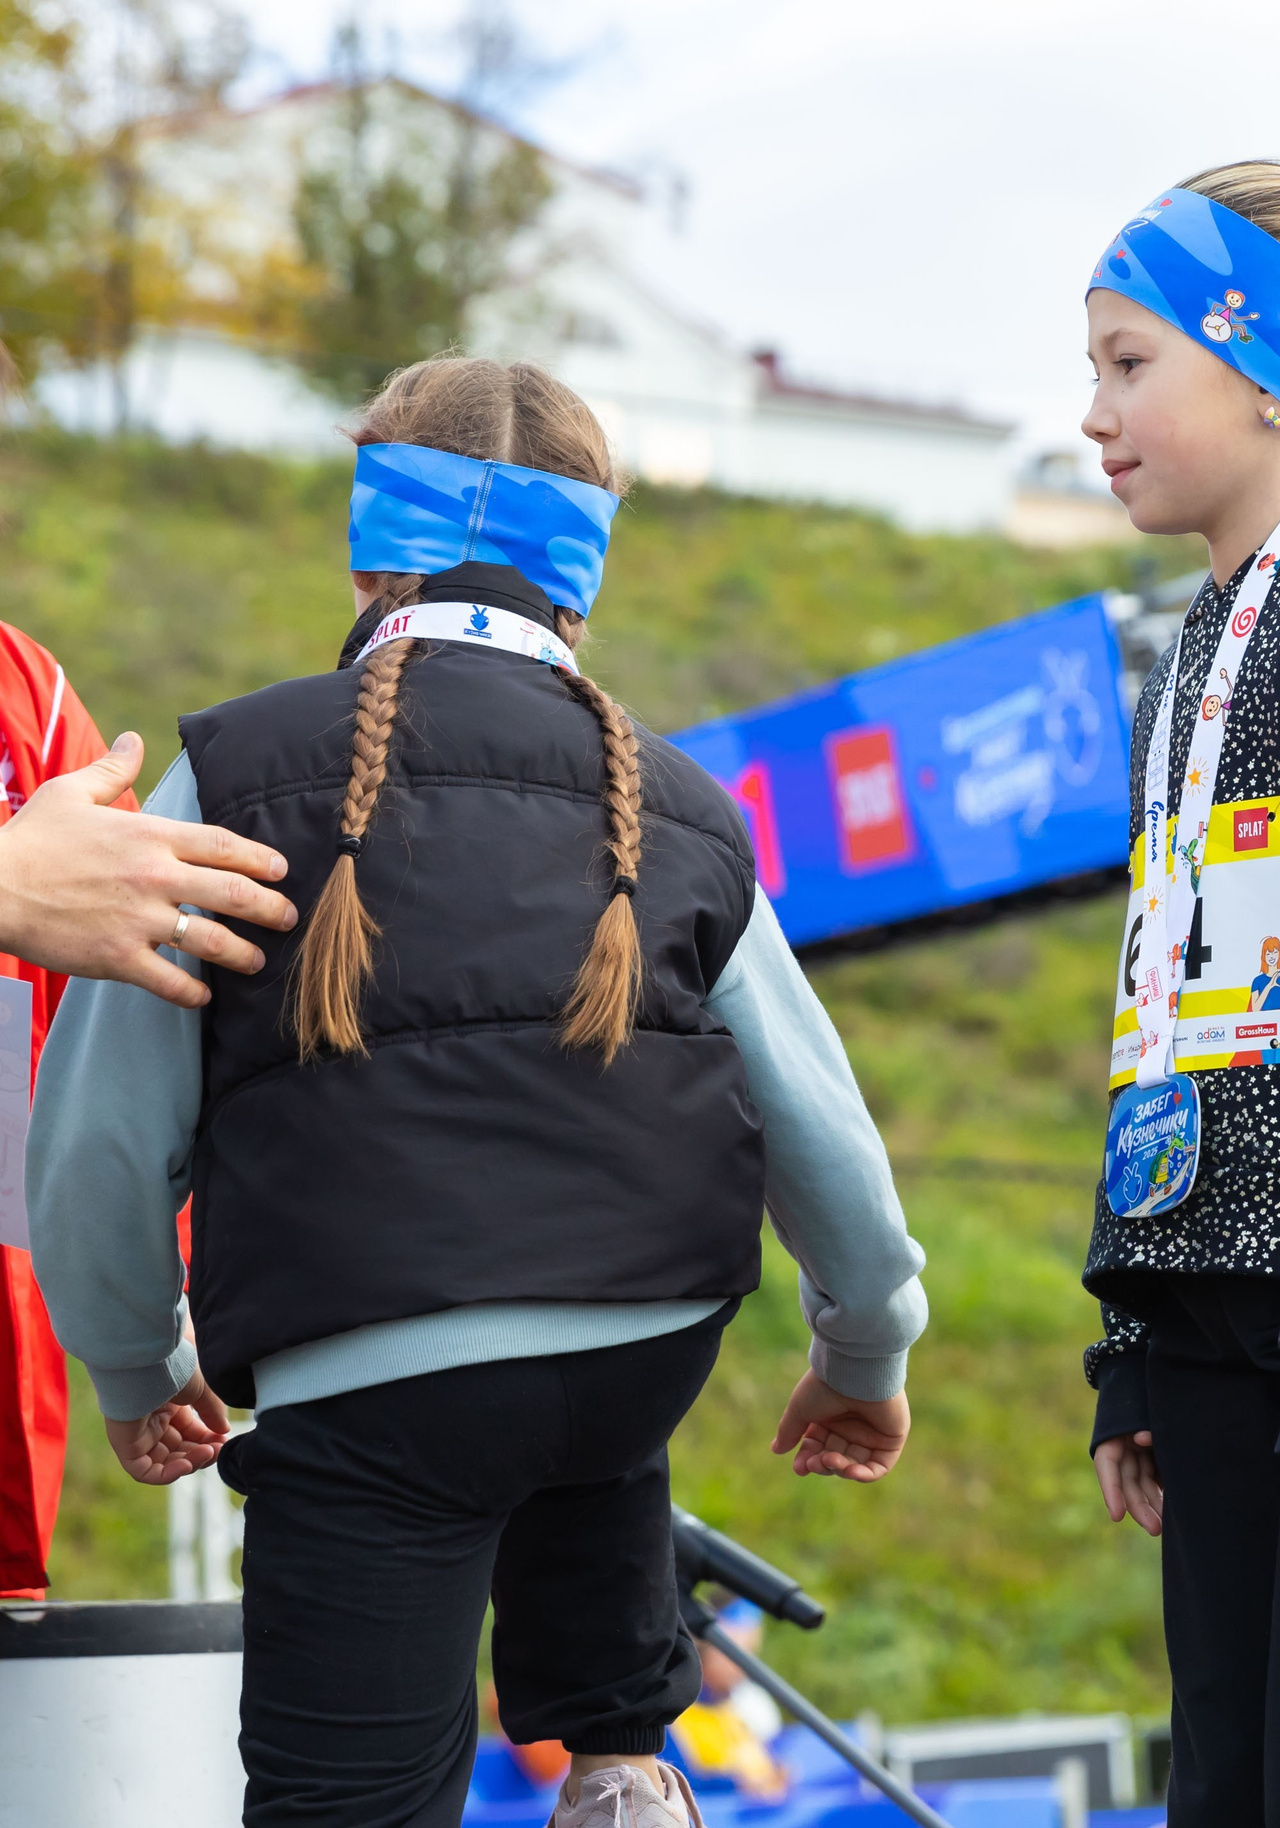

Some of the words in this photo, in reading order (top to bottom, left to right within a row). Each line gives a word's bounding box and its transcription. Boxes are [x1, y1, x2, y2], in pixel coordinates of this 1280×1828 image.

[368, 614, 412, 649] SPLAT
[1238, 820, 1264, 839] SPLAT
[1238, 1026, 1275, 1037] GrossHaus
[1134, 1090, 1173, 1123] ЗАБЕГ
